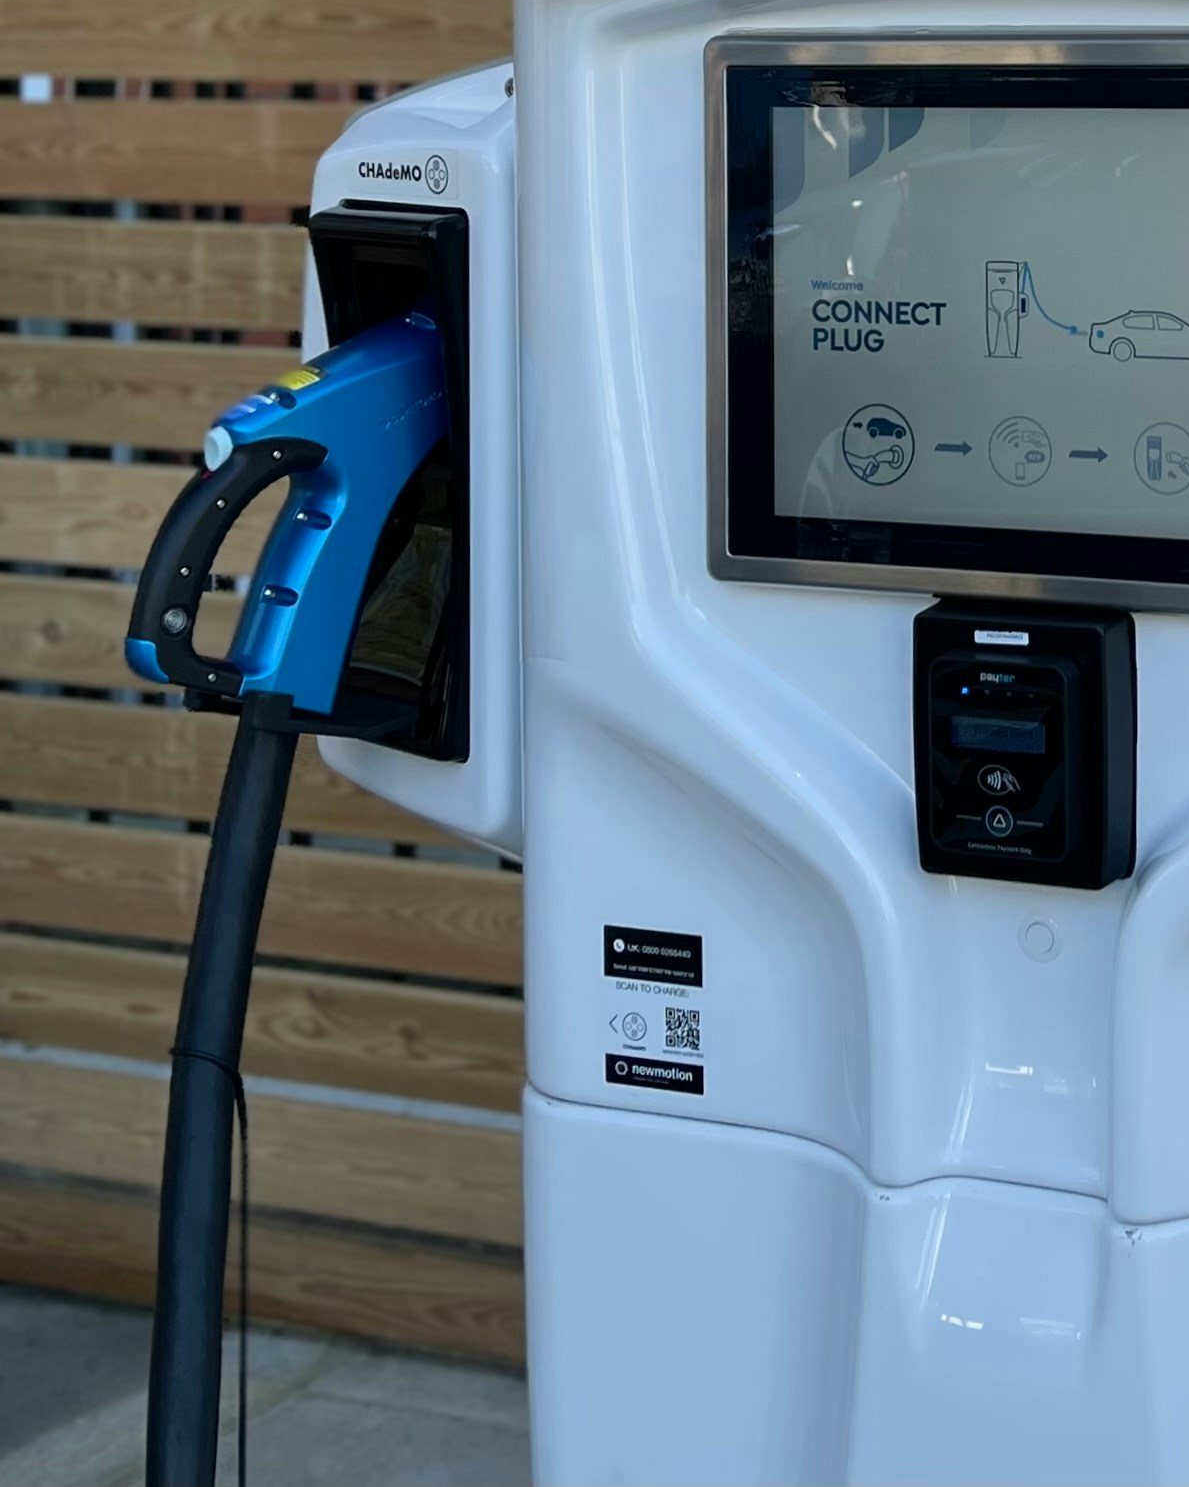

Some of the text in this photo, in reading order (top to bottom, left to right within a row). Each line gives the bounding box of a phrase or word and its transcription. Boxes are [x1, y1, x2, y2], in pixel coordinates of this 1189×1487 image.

[359, 162, 421, 181] CHAdeMO
[811, 280, 863, 291] Welcome
[811, 299, 946, 326] CONNECT
[811, 328, 884, 352] PLUG
[980, 672, 1015, 683] payter
[627, 944, 640, 952] UK:
[616, 981, 638, 991] SCAN
[641, 984, 651, 993] TO
[632, 1065, 692, 1082] newmotion
